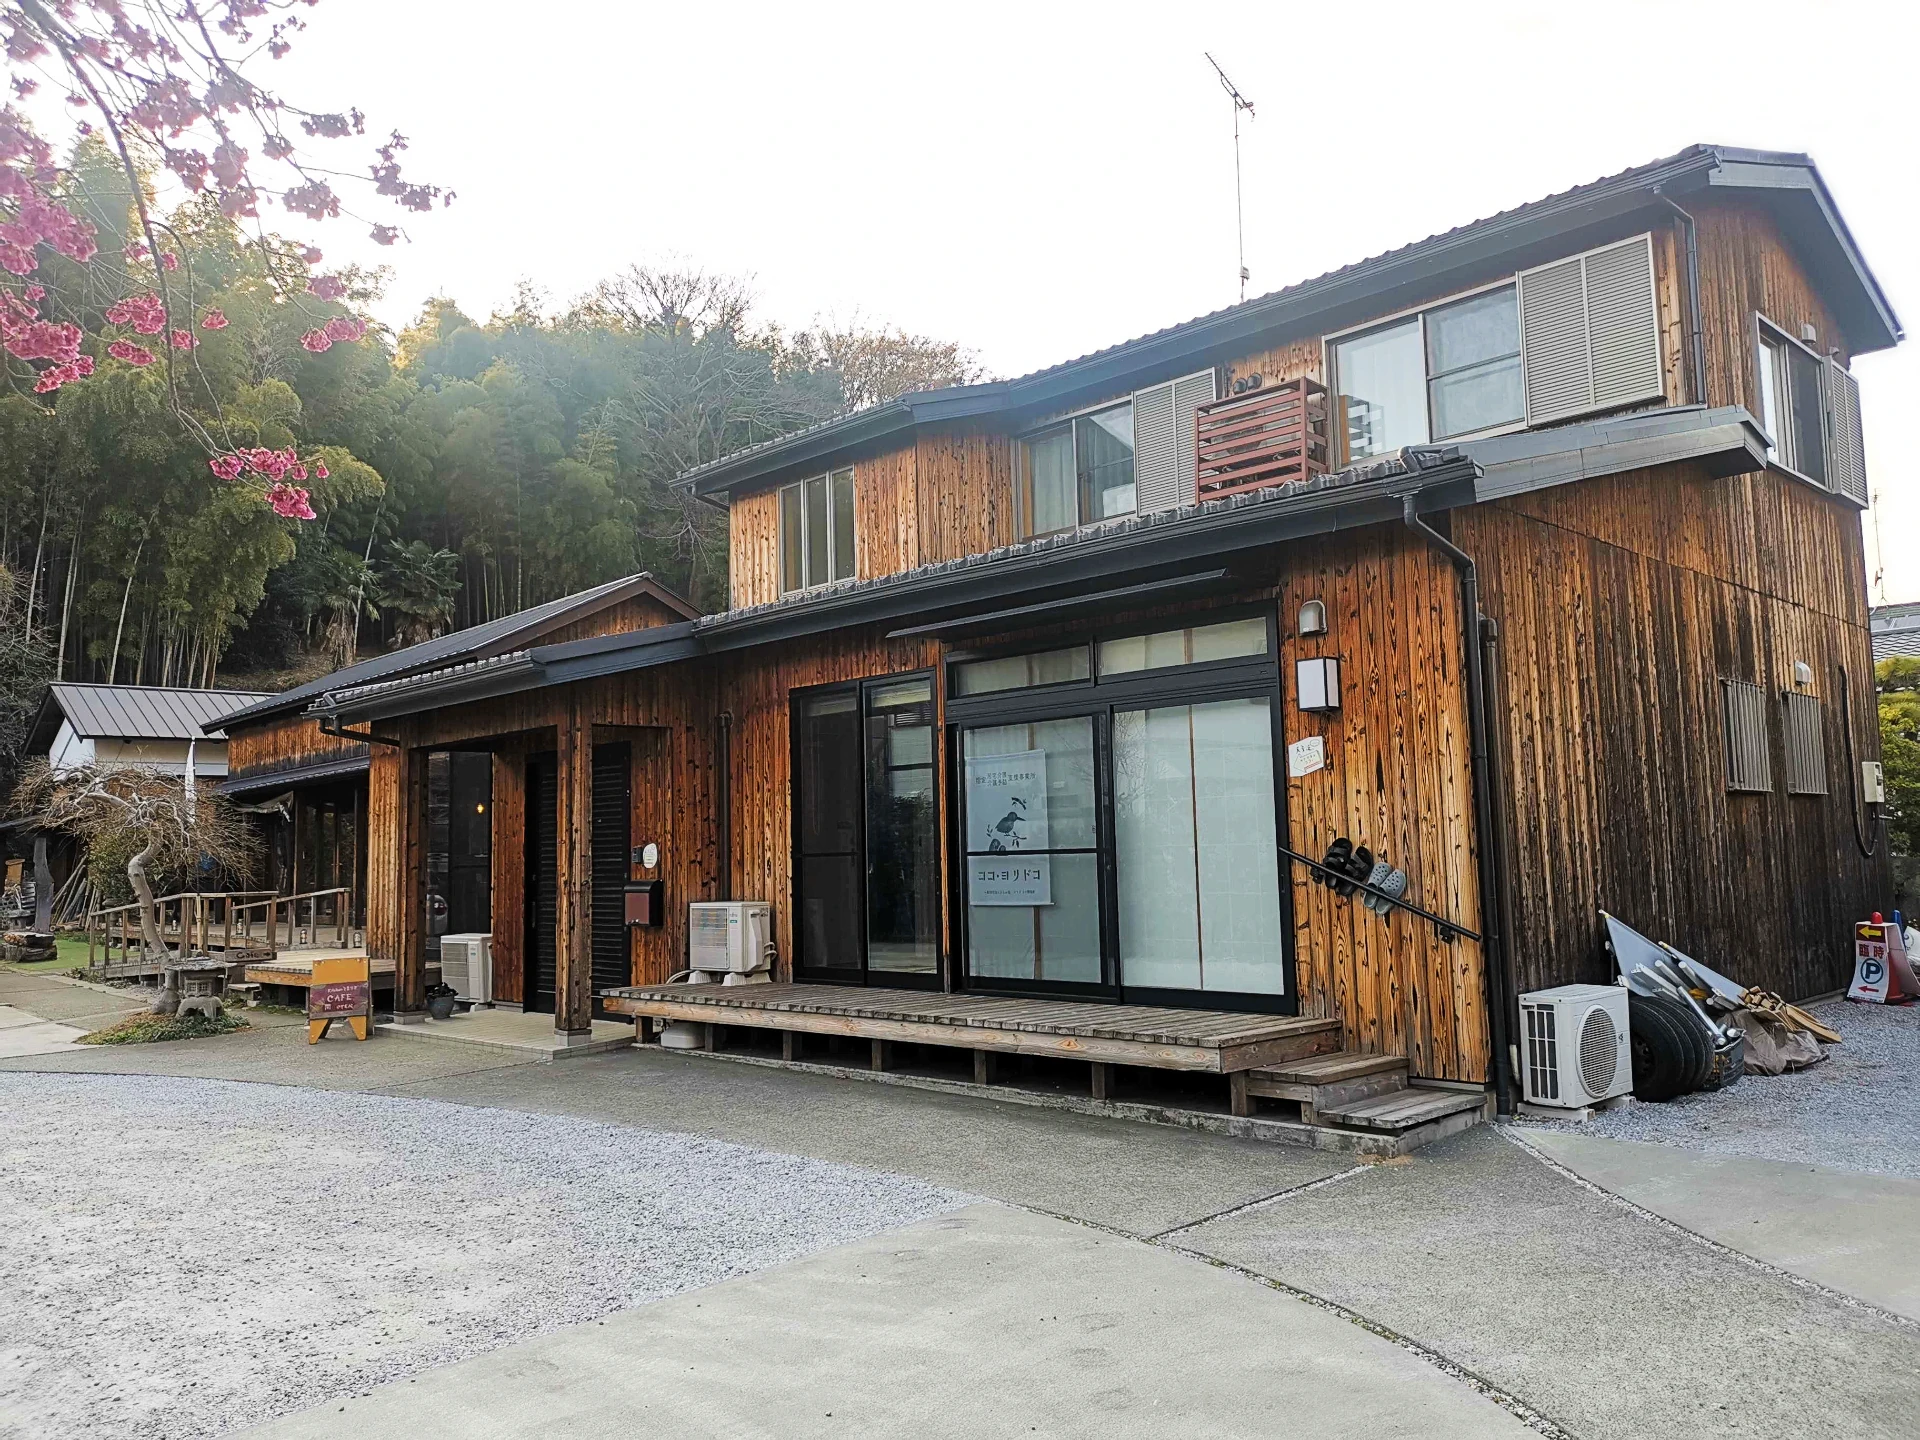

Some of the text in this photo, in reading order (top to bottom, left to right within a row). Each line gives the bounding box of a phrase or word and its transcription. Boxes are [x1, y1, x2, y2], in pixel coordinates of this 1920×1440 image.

[978, 869, 1040, 881] ココ・ヨリドコ
[1859, 944, 1884, 959] 臨時
[1865, 963, 1880, 979] P
[326, 993, 352, 1003] CAFE
